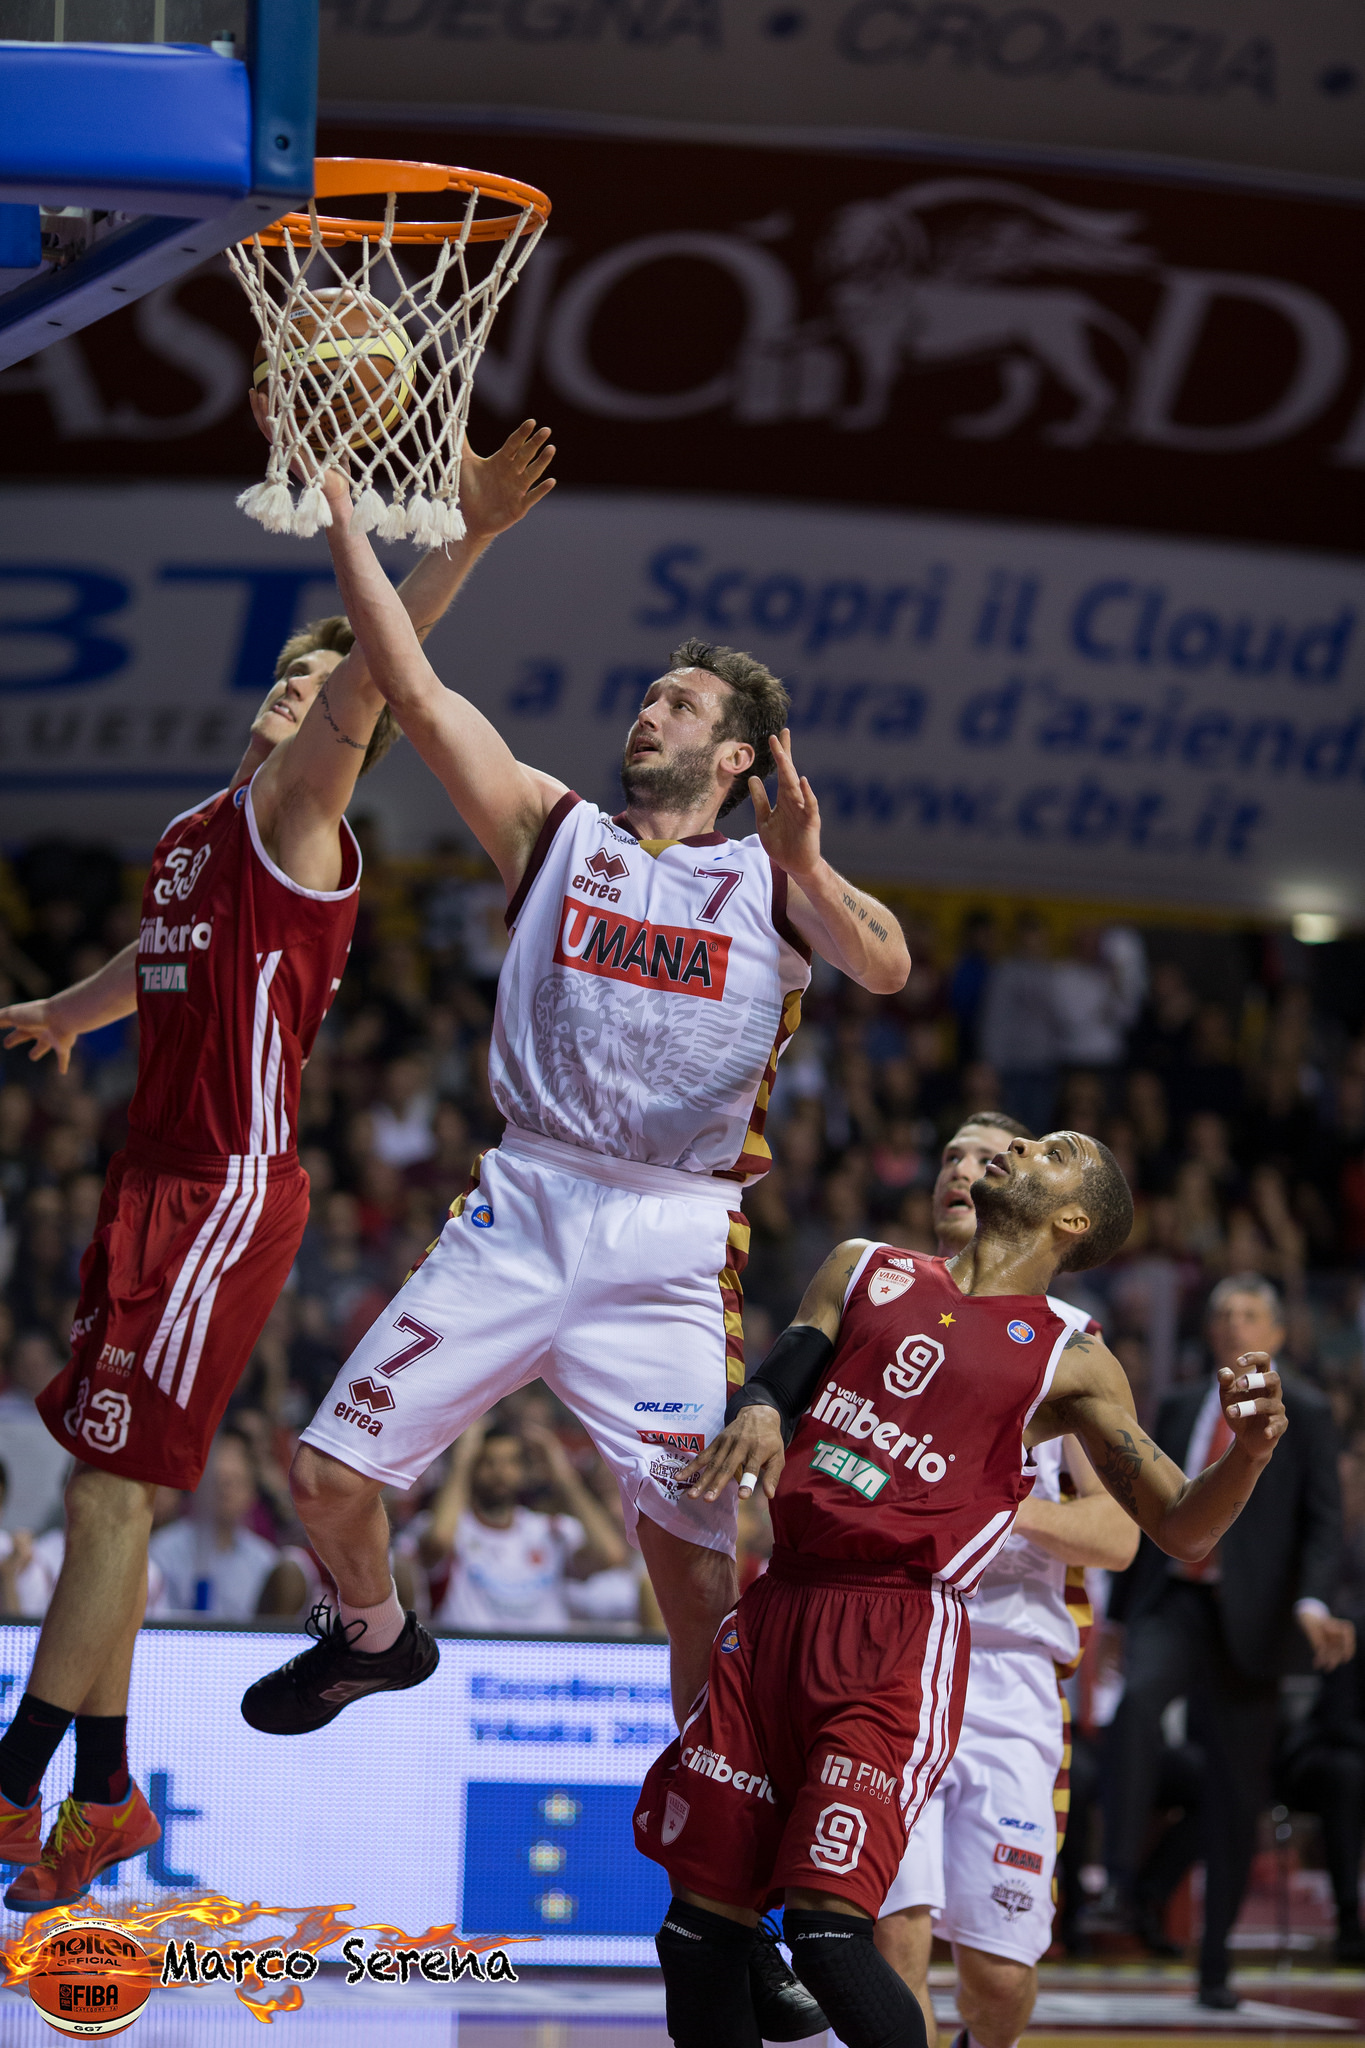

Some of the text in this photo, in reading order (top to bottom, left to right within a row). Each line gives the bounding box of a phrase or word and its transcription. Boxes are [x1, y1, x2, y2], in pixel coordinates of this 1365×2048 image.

[638, 542, 1354, 684] Scopri il Cloud
[572, 874, 622, 904] errea
[693, 867, 744, 924] 7
[858, 908, 868, 921] IV
[561, 907, 713, 988] UMANA
[141, 965, 187, 991] TEVA
[879, 1271, 910, 1285] VARESE
[99, 1342, 136, 1370] FIM
[373, 1311, 444, 1379] 7
[95, 1361, 131, 1378] group
[882, 1333, 946, 1399] 9
[333, 1401, 384, 1437] errea
[812, 1442, 888, 1499] TEVA
[853, 1782, 891, 1805] group
[856, 1762, 898, 1797] FIM
[809, 1802, 868, 1875] 9
